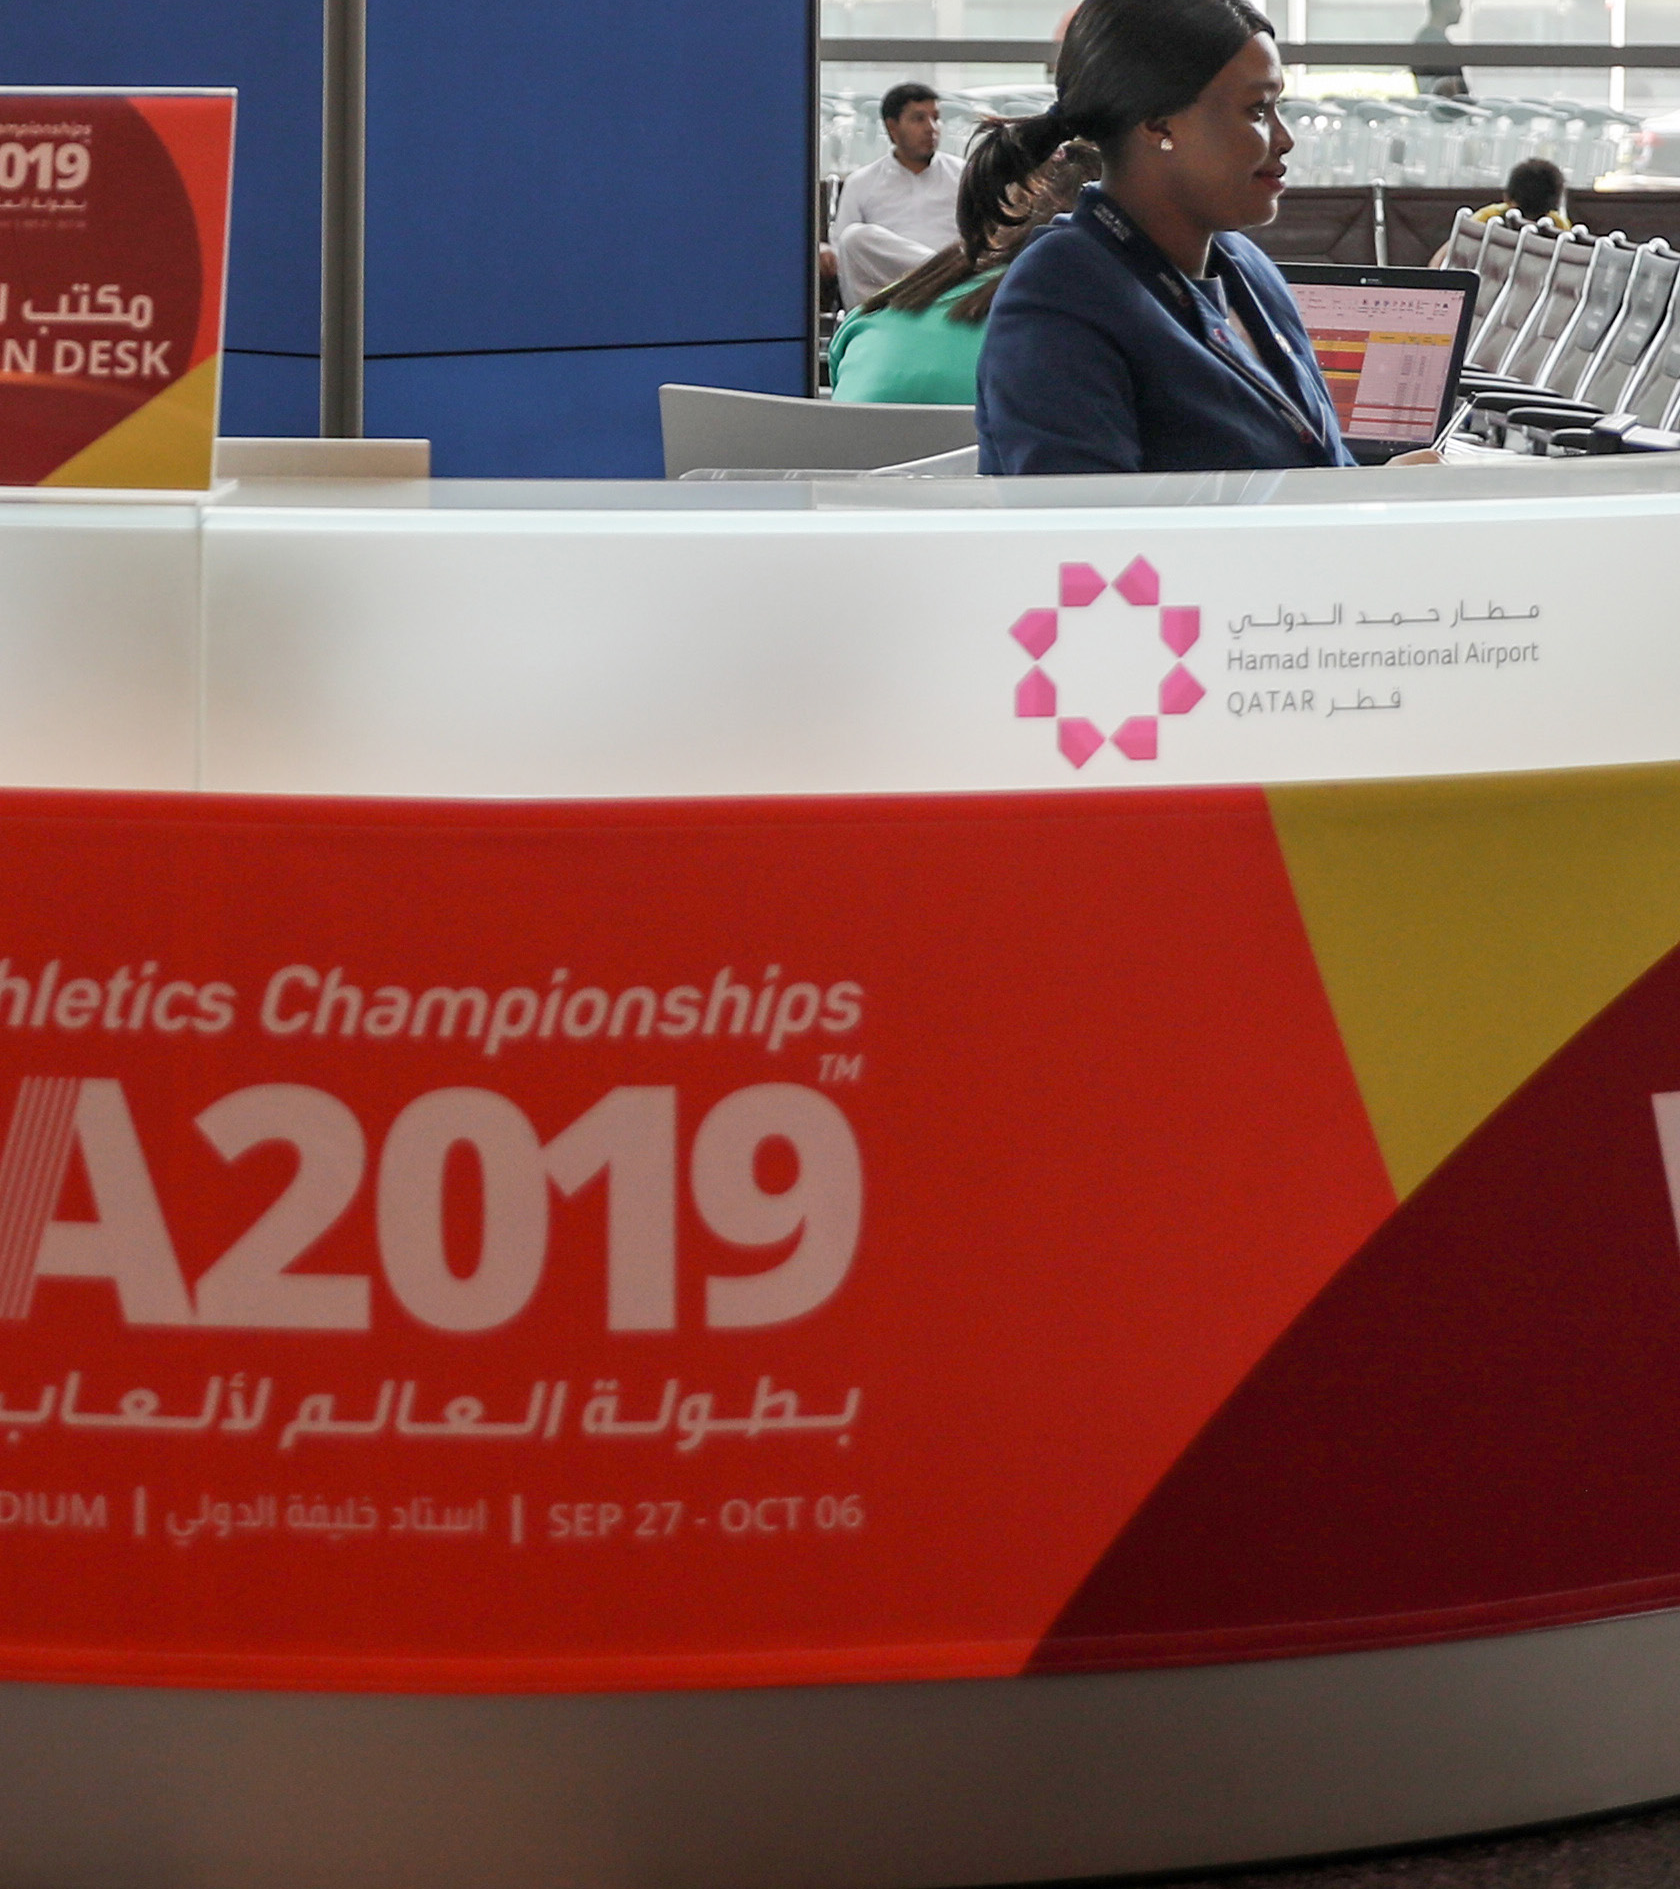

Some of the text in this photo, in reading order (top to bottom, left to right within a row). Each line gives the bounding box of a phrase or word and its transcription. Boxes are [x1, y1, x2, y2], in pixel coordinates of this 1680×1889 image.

[22, 284, 152, 334] مكتب
[53, 340, 170, 377] DESK
[1227, 601, 1540, 640] مطار حمد الدولي
[1228, 641, 1539, 670] Hamad International Airport
[1226, 686, 1402, 718] QATAR قطر
[261, 964, 863, 1060] Championships
[279, 1380, 567, 1449] العالم
[582, 1376, 861, 1452] بطولة
[549, 1503, 623, 1538] SEP
[635, 1501, 683, 1538] 27
[720, 1497, 804, 1533] OCT
[815, 1494, 864, 1530] 06
